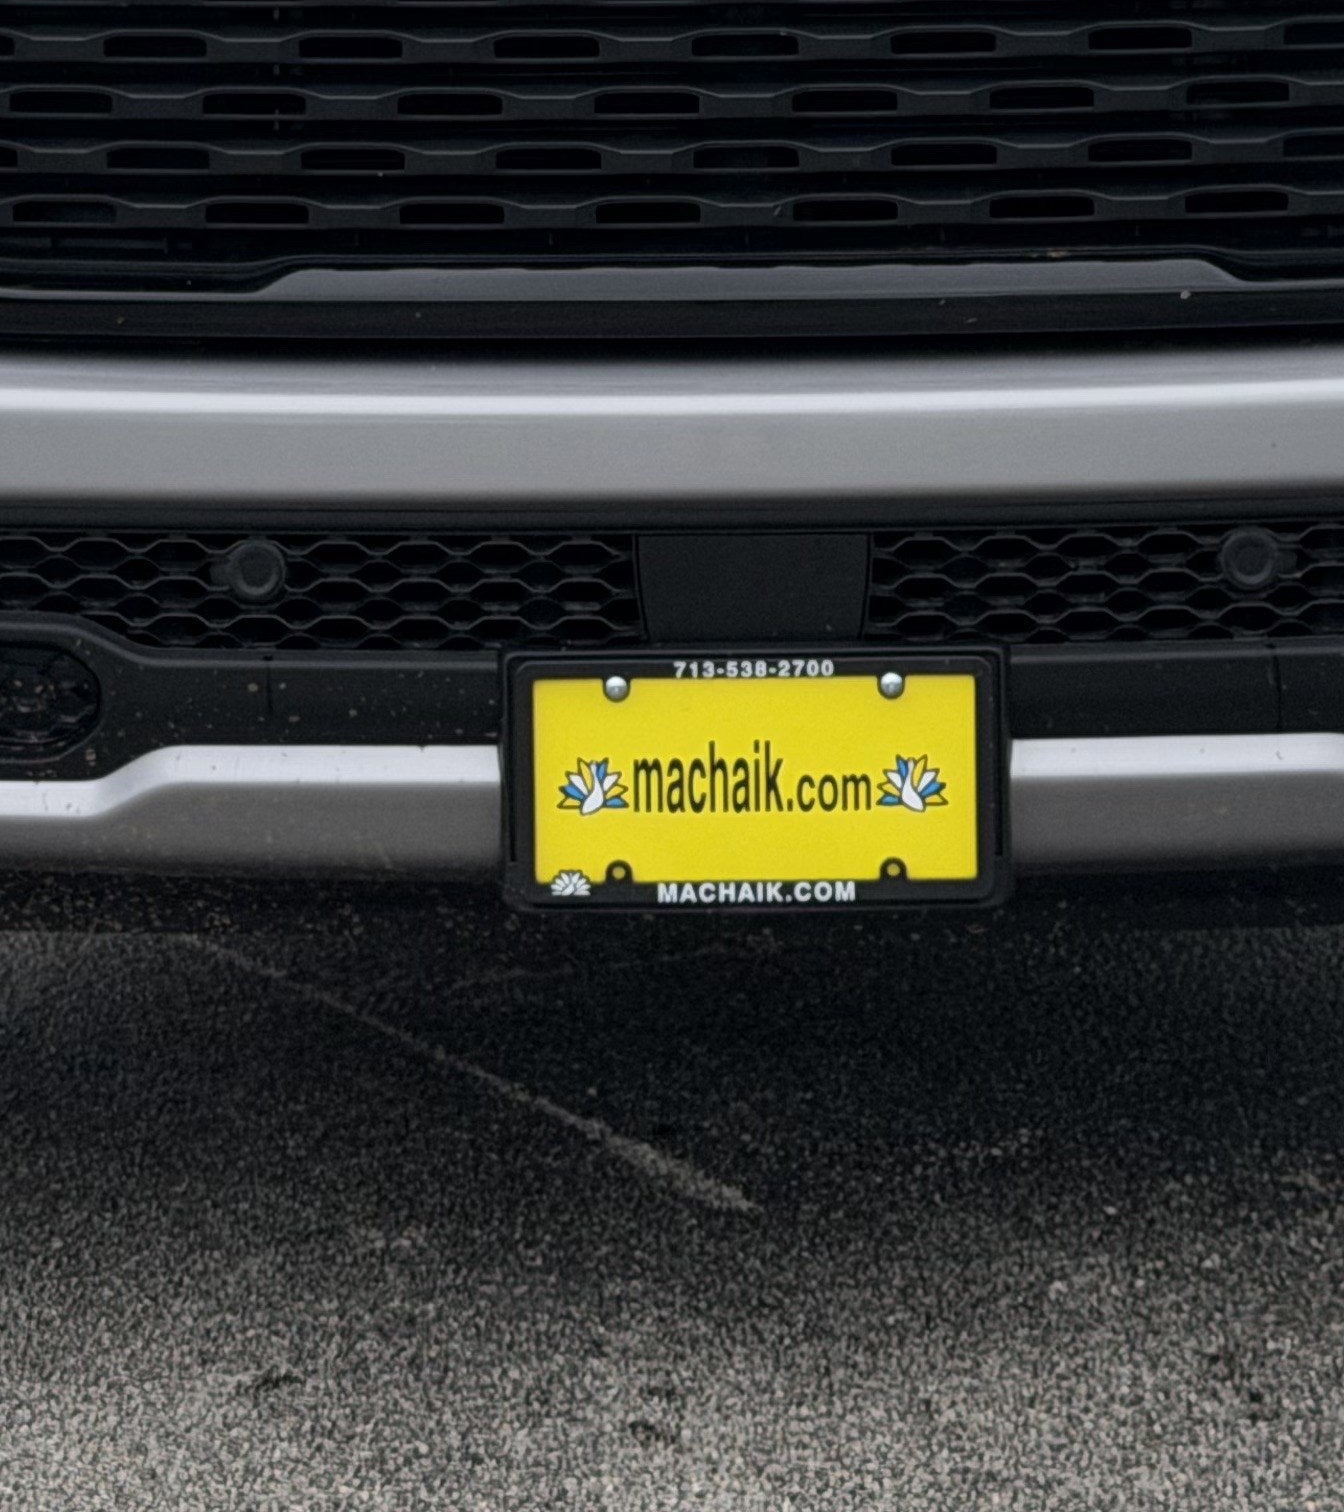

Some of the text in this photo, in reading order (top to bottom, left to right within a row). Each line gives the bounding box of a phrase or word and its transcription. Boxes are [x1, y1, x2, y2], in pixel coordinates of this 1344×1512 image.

[672, 659, 835, 679] 713-538-2700
[632, 739, 872, 814] machaik.com
[657, 880, 856, 904] MACHAIK.COM
